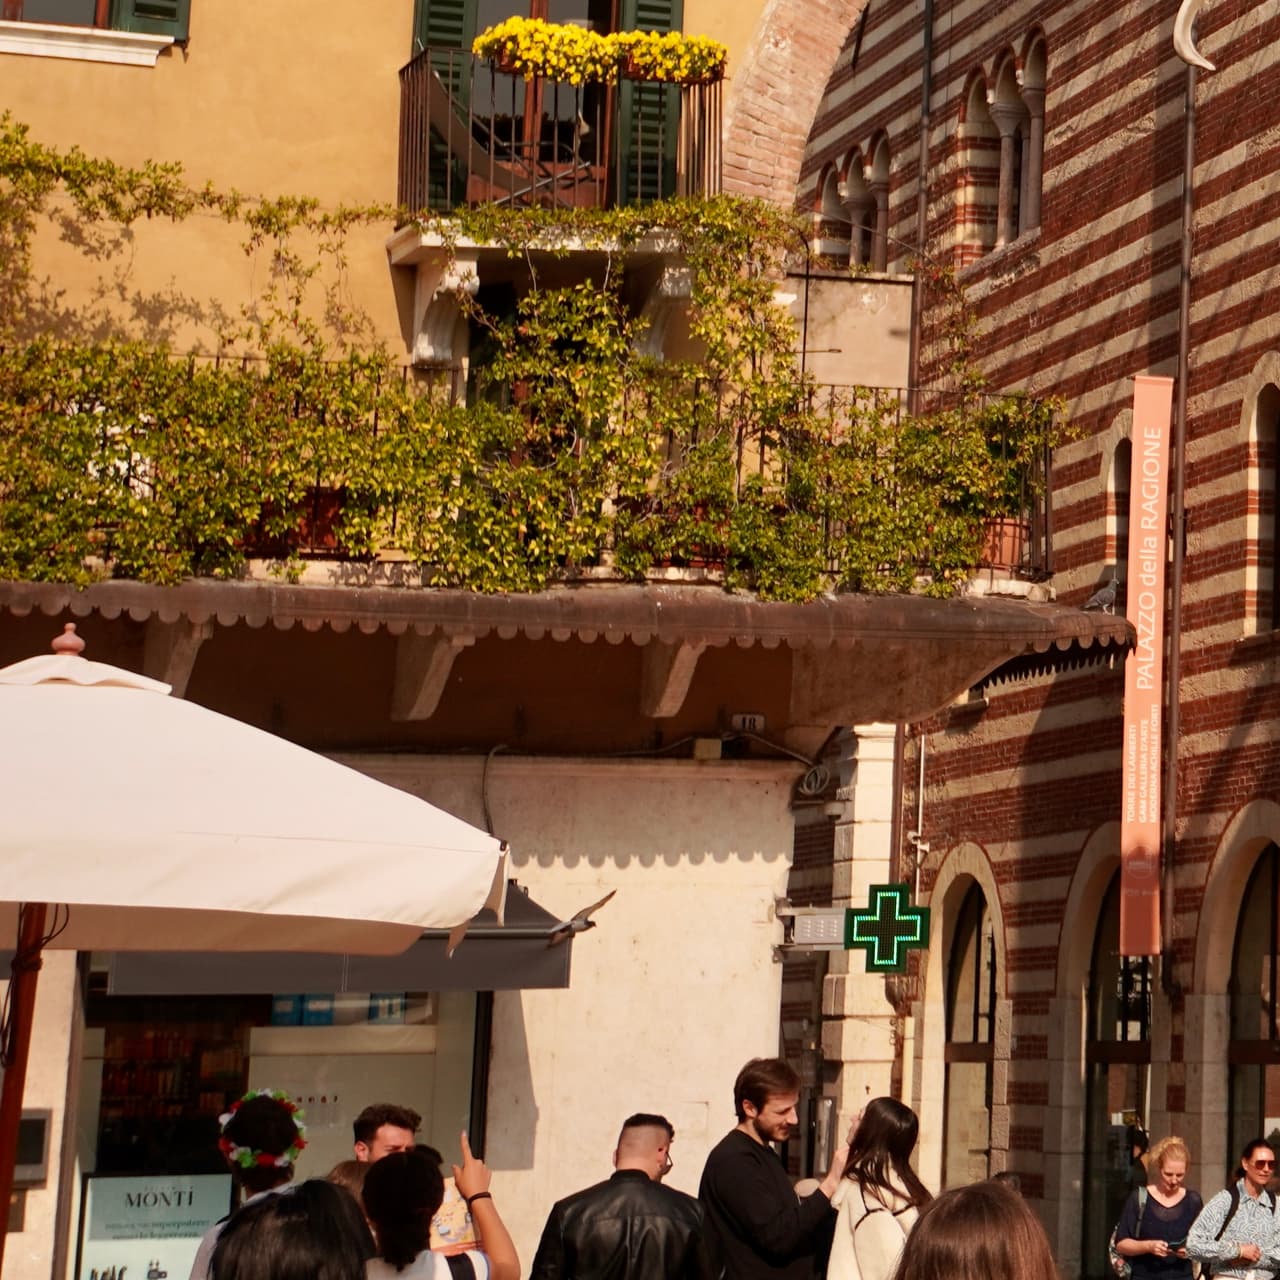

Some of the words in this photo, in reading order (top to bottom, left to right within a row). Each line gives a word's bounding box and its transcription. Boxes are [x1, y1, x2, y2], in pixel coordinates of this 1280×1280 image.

[1141, 427, 1161, 530] RAGIONE
[1139, 536, 1157, 586] della
[1137, 590, 1157, 690] PALAZZO
[1151, 704, 1159, 732] FORTI
[1128, 724, 1137, 771] LAMBERTI
[1150, 735, 1158, 771] ACHILLE
[1128, 773, 1136, 789] DEI
[1139, 753, 1148, 798] GALLERIA
[1149, 773, 1158, 823] MODERNA
[1127, 791, 1136, 823] TORRE
[1139, 800, 1147, 823] GAM
